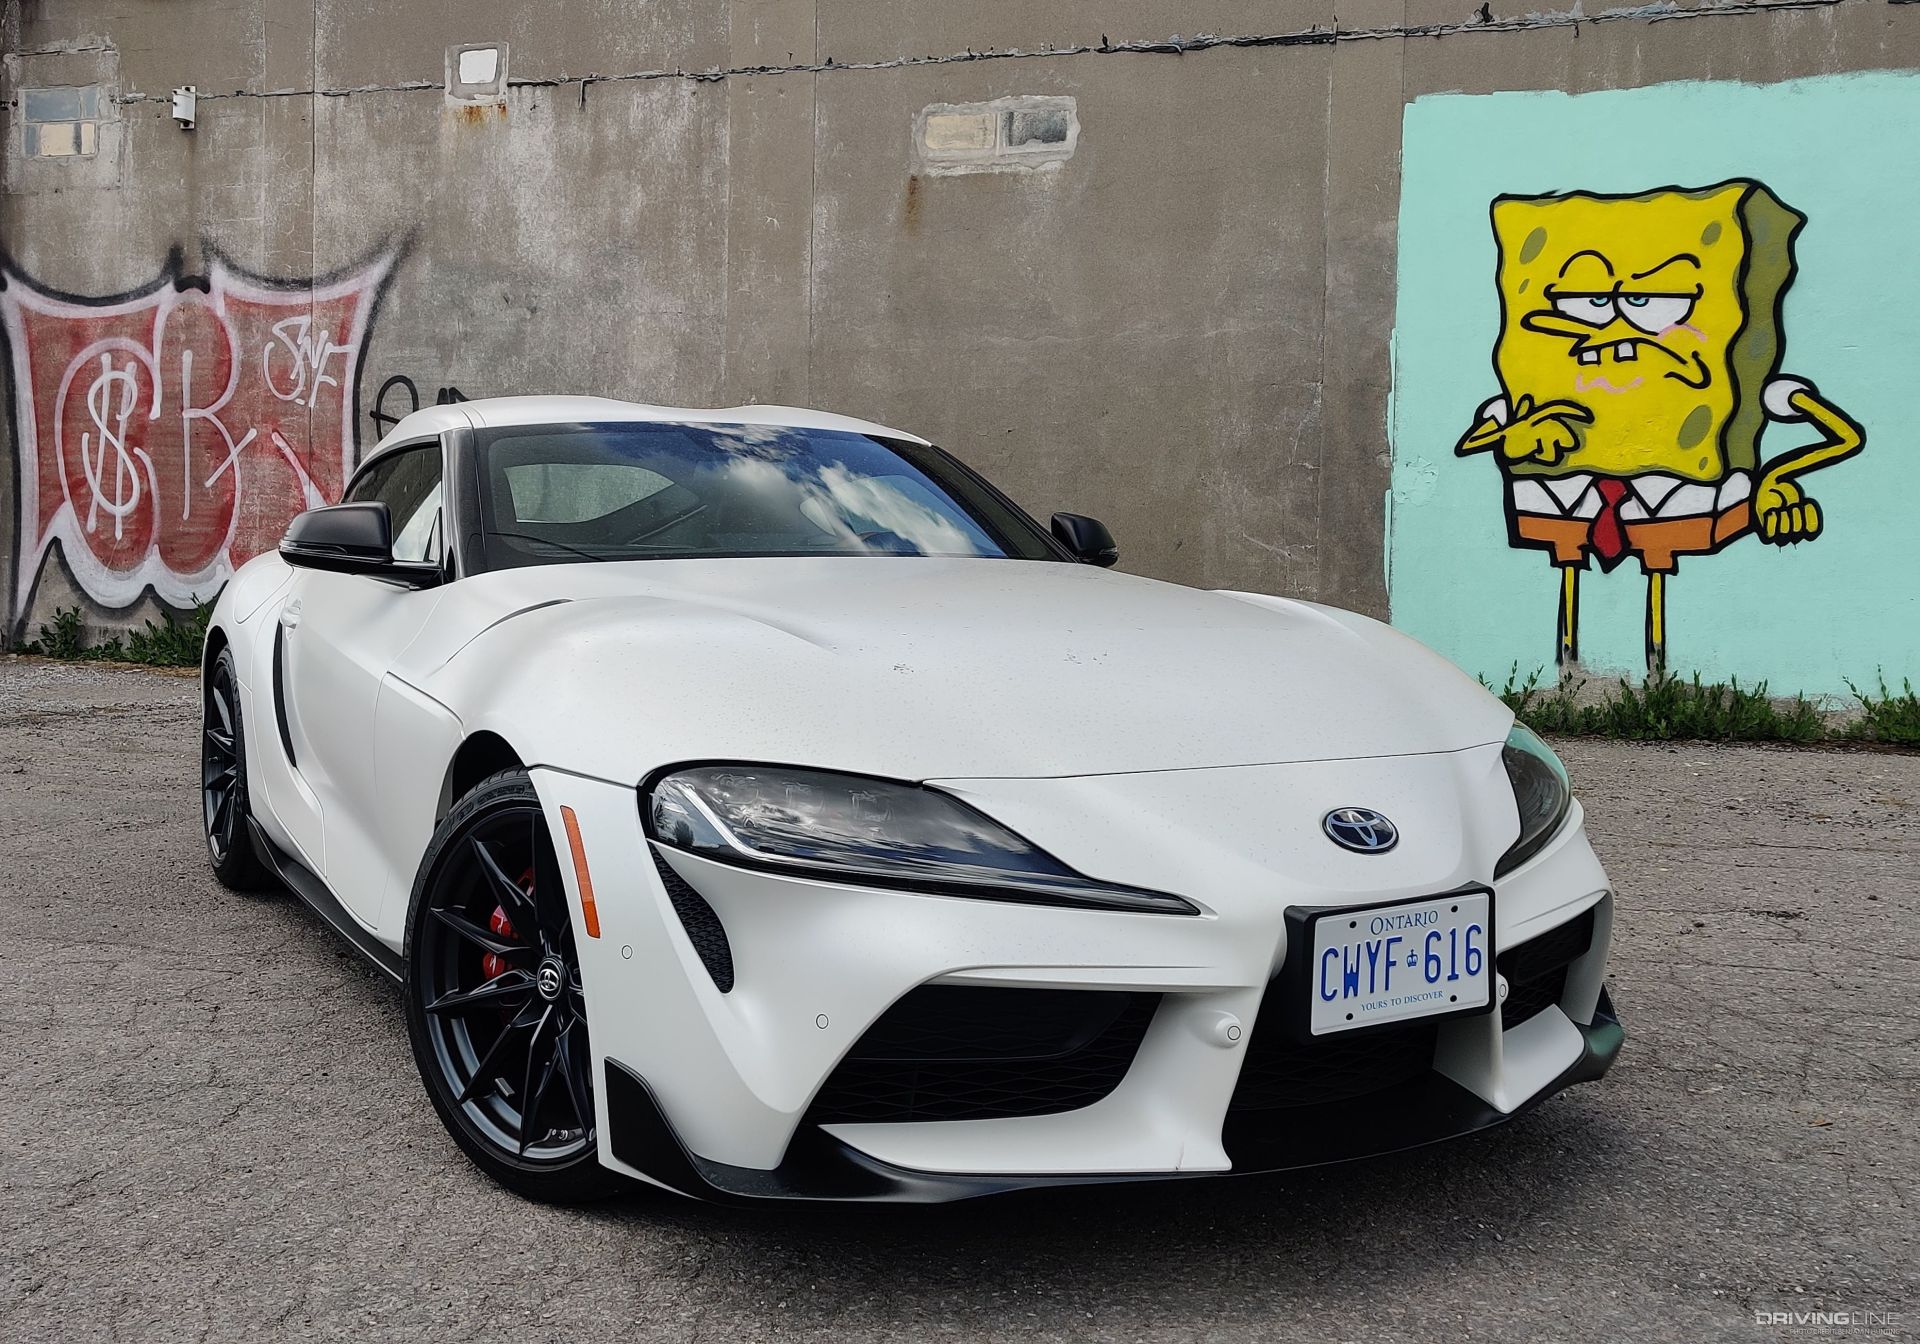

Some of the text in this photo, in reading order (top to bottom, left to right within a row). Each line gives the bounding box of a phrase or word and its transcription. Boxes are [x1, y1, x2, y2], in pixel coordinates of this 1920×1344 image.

[1370, 910, 1439, 935] ONTARIO
[1320, 924, 1482, 1001] CWYF 616
[1361, 990, 1444, 1012] YOURS TO DISCOVER
